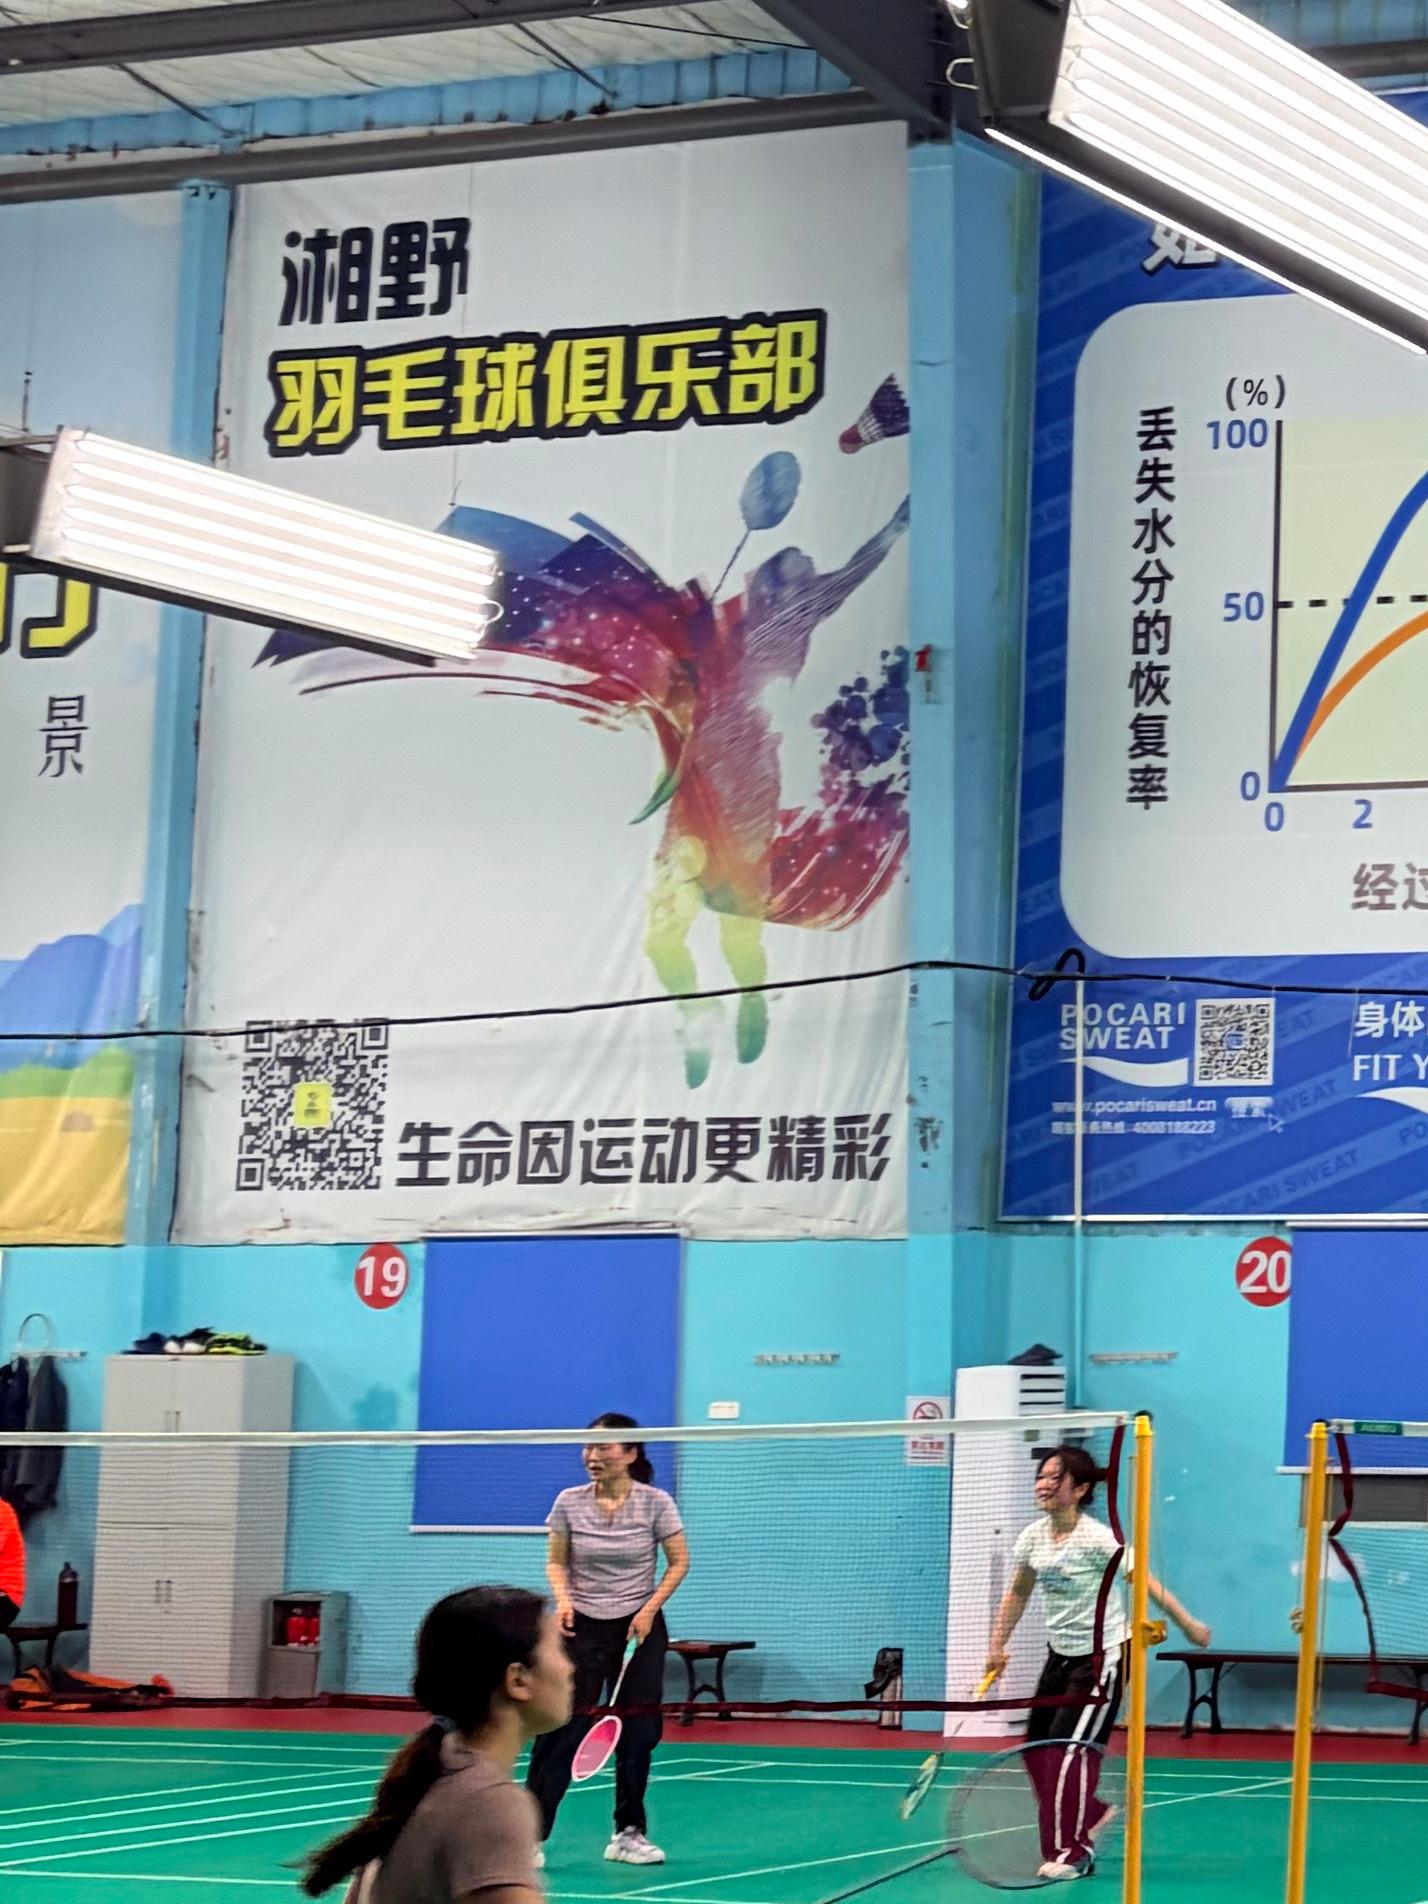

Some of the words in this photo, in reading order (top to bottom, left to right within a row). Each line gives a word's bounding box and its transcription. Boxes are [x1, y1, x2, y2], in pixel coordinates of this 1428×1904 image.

[279, 217, 472, 327] 湘野
[268, 310, 827, 454] 羽毛球俱乐部
[1206, 418, 1268, 449] 100
[1126, 406, 1177, 810] 丢失水分的恢复率
[1223, 591, 1264, 622] 50
[37, 694, 89, 778] 景
[1240, 771, 1260, 800] 0
[1264, 801, 1285, 832] 0
[1352, 798, 1373, 829] 2
[1061, 1001, 1187, 1027] POCARI
[1059, 1026, 1175, 1050] SWEAT
[1353, 1054, 1402, 1081] FIT
[395, 1114, 891, 1187] 生命因运动更精彩
[357, 1256, 409, 1299] 19
[1238, 1250, 1292, 1294] 20
